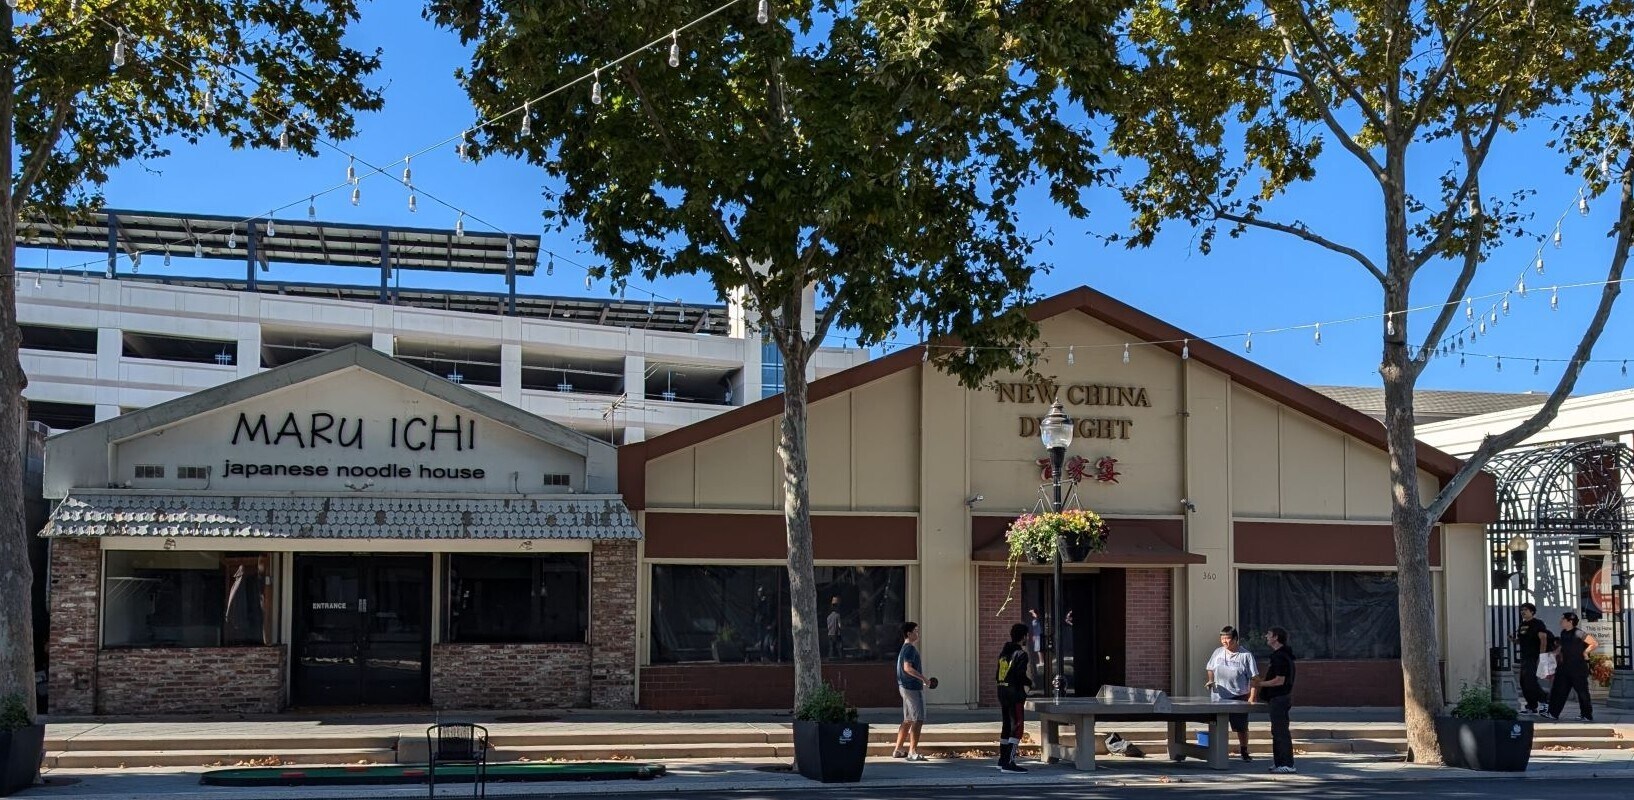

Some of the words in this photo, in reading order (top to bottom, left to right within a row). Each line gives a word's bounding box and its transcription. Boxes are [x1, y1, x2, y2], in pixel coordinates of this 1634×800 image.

[997, 383, 1060, 404] NEW
[1067, 385, 1152, 407] CHINA
[231, 412, 363, 449] MARU
[390, 414, 475, 451] ICHI
[1019, 417, 1133, 439] DIGHT
[222, 460, 328, 478] japanese
[337, 463, 411, 478] noodle
[419, 464, 485, 479] house
[1202, 571, 1217, 580] 360
[312, 602, 346, 610] ENTRANCE
